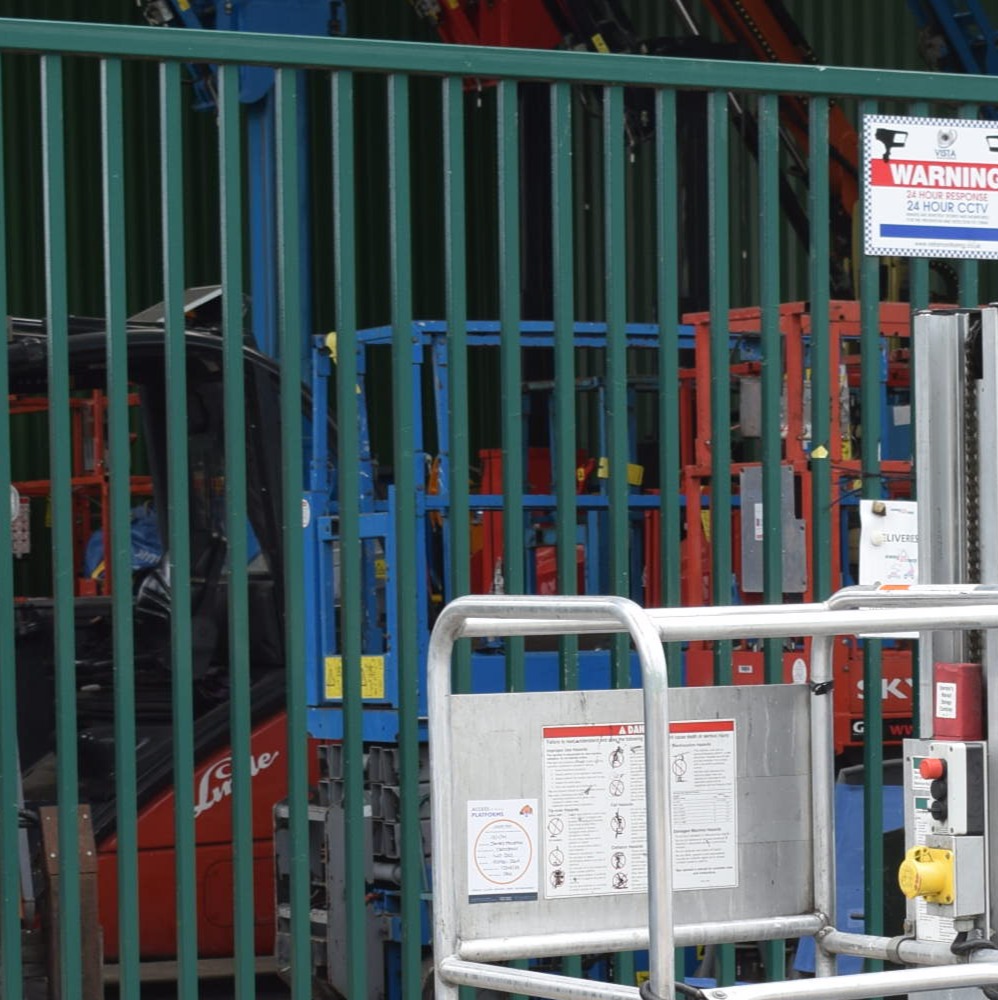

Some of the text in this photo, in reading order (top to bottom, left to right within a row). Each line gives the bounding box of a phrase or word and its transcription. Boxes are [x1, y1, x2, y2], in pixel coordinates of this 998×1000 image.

[906, 190, 988, 201] 24 HOUR RESPONSE
[906, 200, 988, 213] 24 HOUR CCTV
[627, 724, 645, 735] DAN
